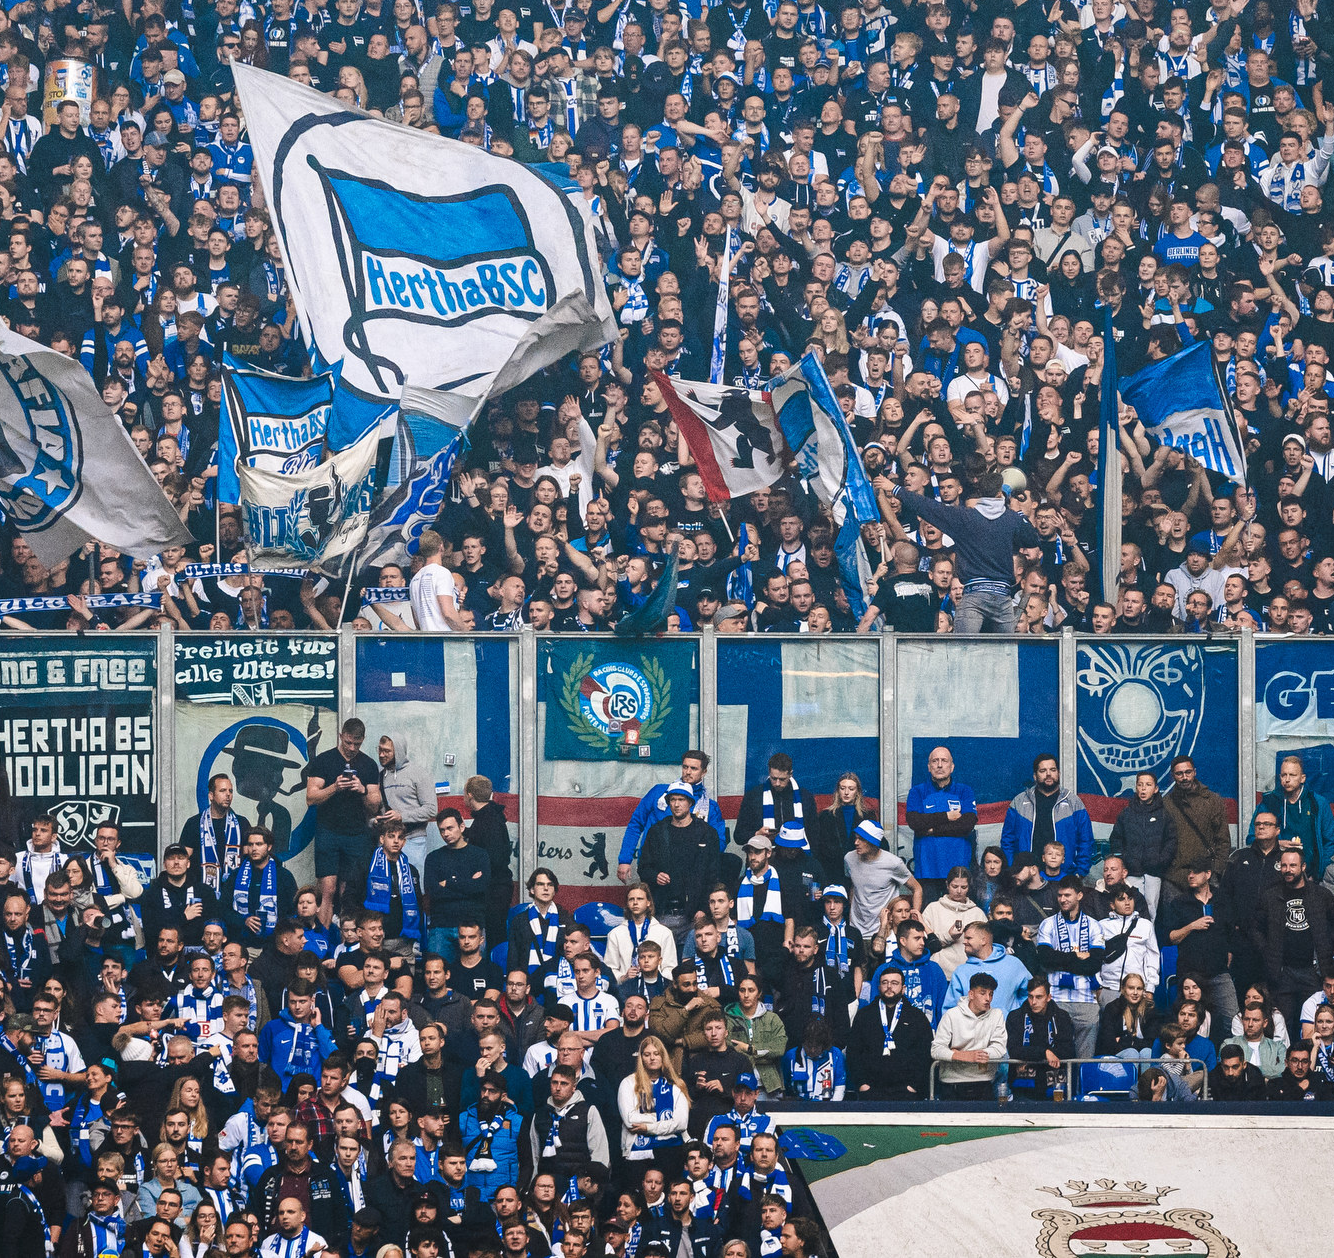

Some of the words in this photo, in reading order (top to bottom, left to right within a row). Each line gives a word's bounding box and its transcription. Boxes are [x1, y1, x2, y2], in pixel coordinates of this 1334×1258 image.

[366, 255, 546, 316] HerthaBSC
[249, 403, 331, 450] HerthaBSC
[184, 562, 243, 579] ULTRAS
[287, 638, 336, 657] für
[46, 659, 67, 687] &
[175, 664, 224, 684] alle
[232, 659, 335, 681] Ultras!
[593, 664, 617, 677] RACING
[114, 716, 151, 748] BS
